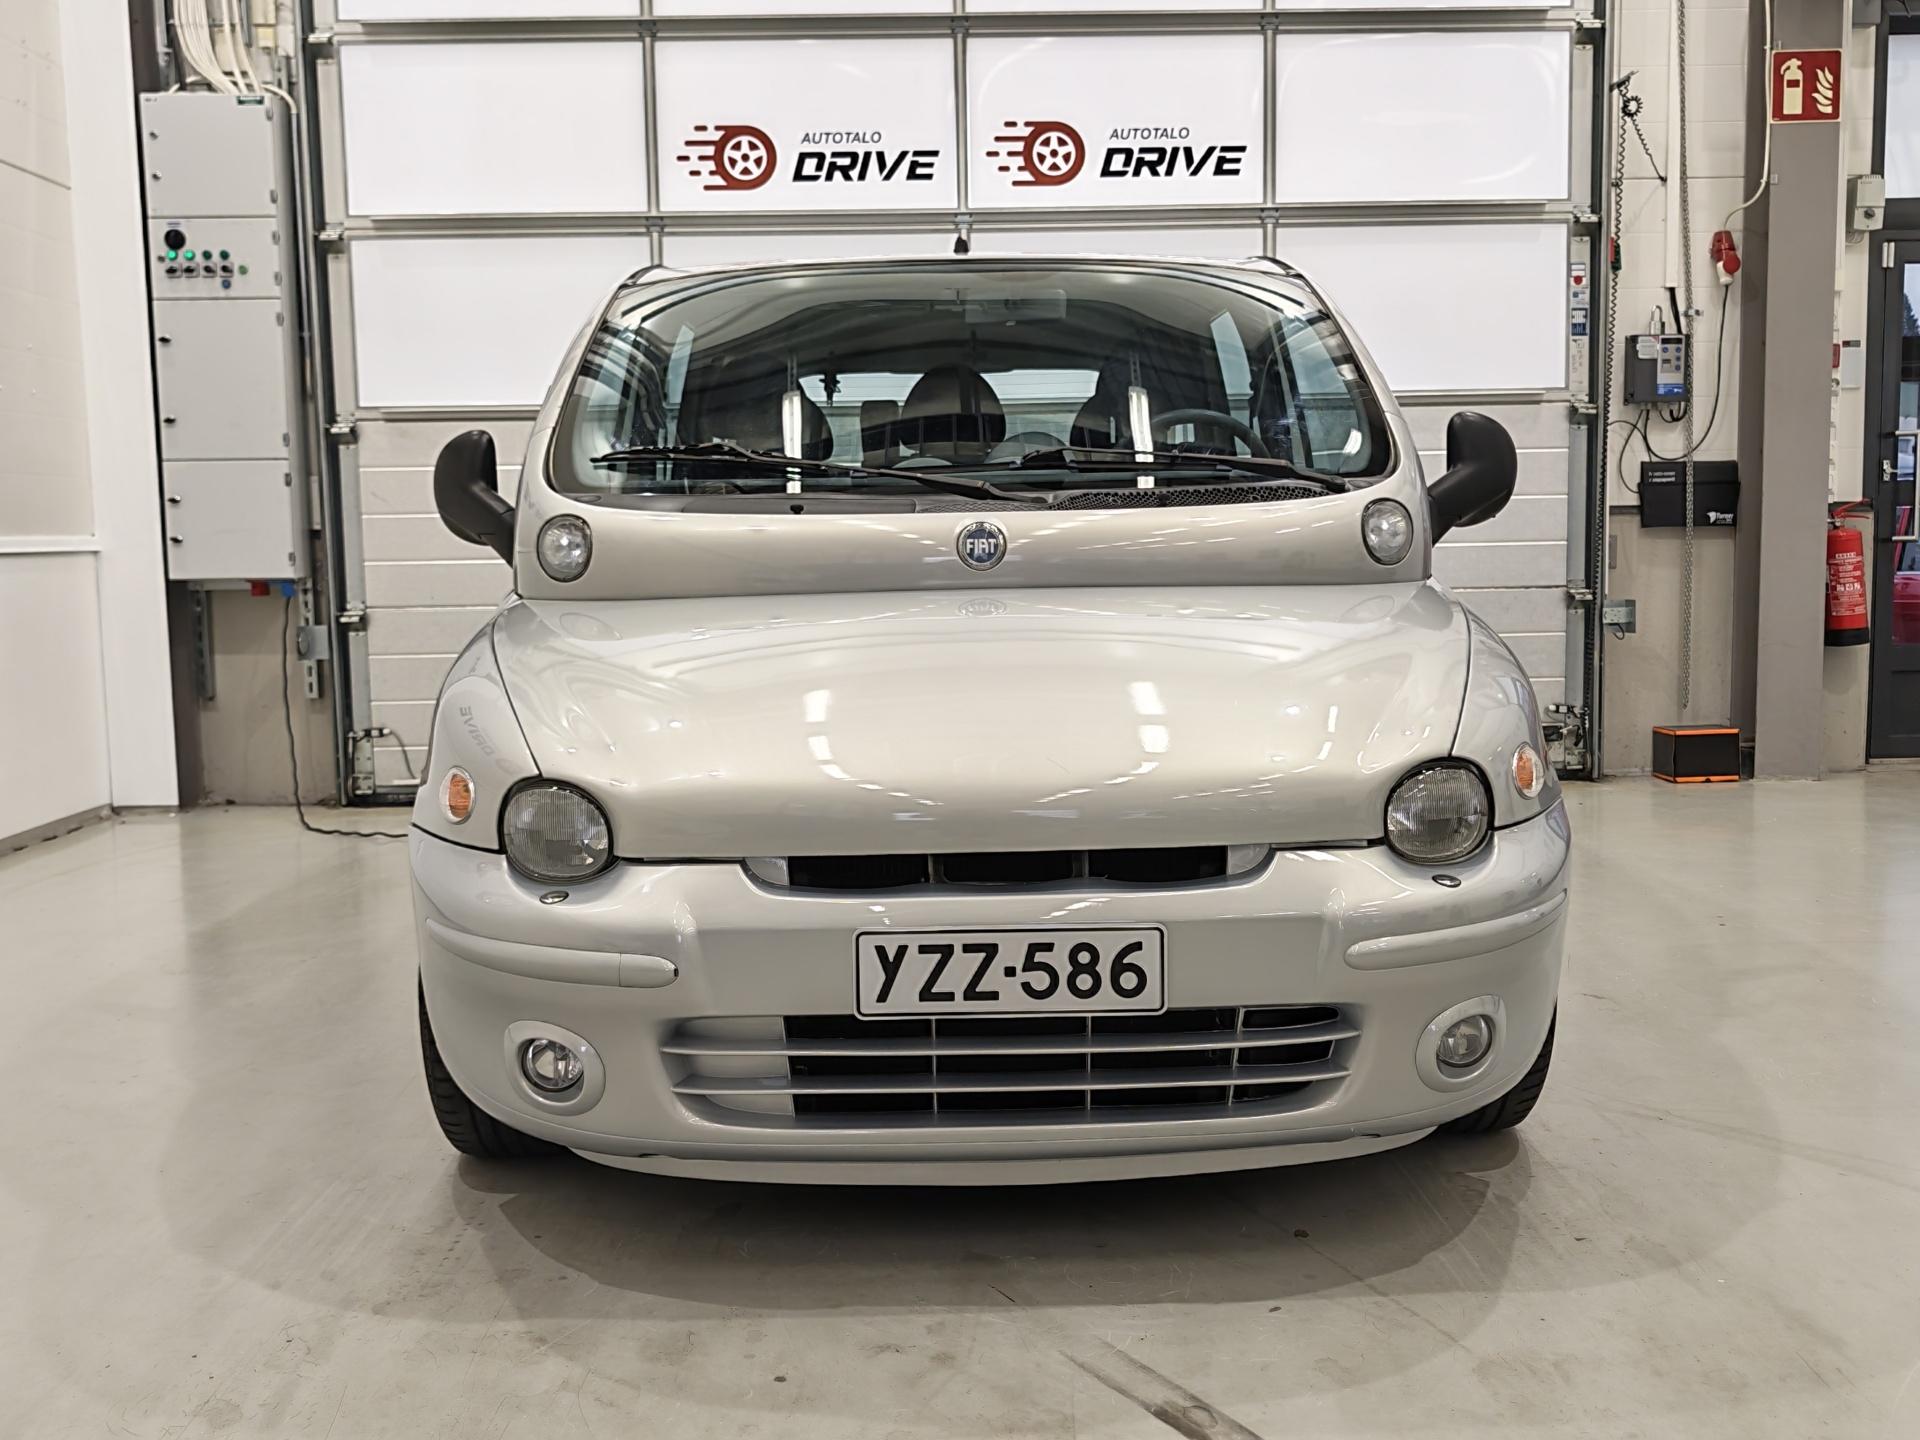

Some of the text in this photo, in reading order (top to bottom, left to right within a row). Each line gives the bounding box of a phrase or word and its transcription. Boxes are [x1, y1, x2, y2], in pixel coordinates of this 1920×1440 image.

[801, 131, 882, 144] AUTOTALO
[1109, 127, 1190, 140] AUTOTALO
[792, 149, 940, 182] DRIVE
[1099, 145, 1248, 178] DRIVE
[966, 538, 997, 554] FIAT
